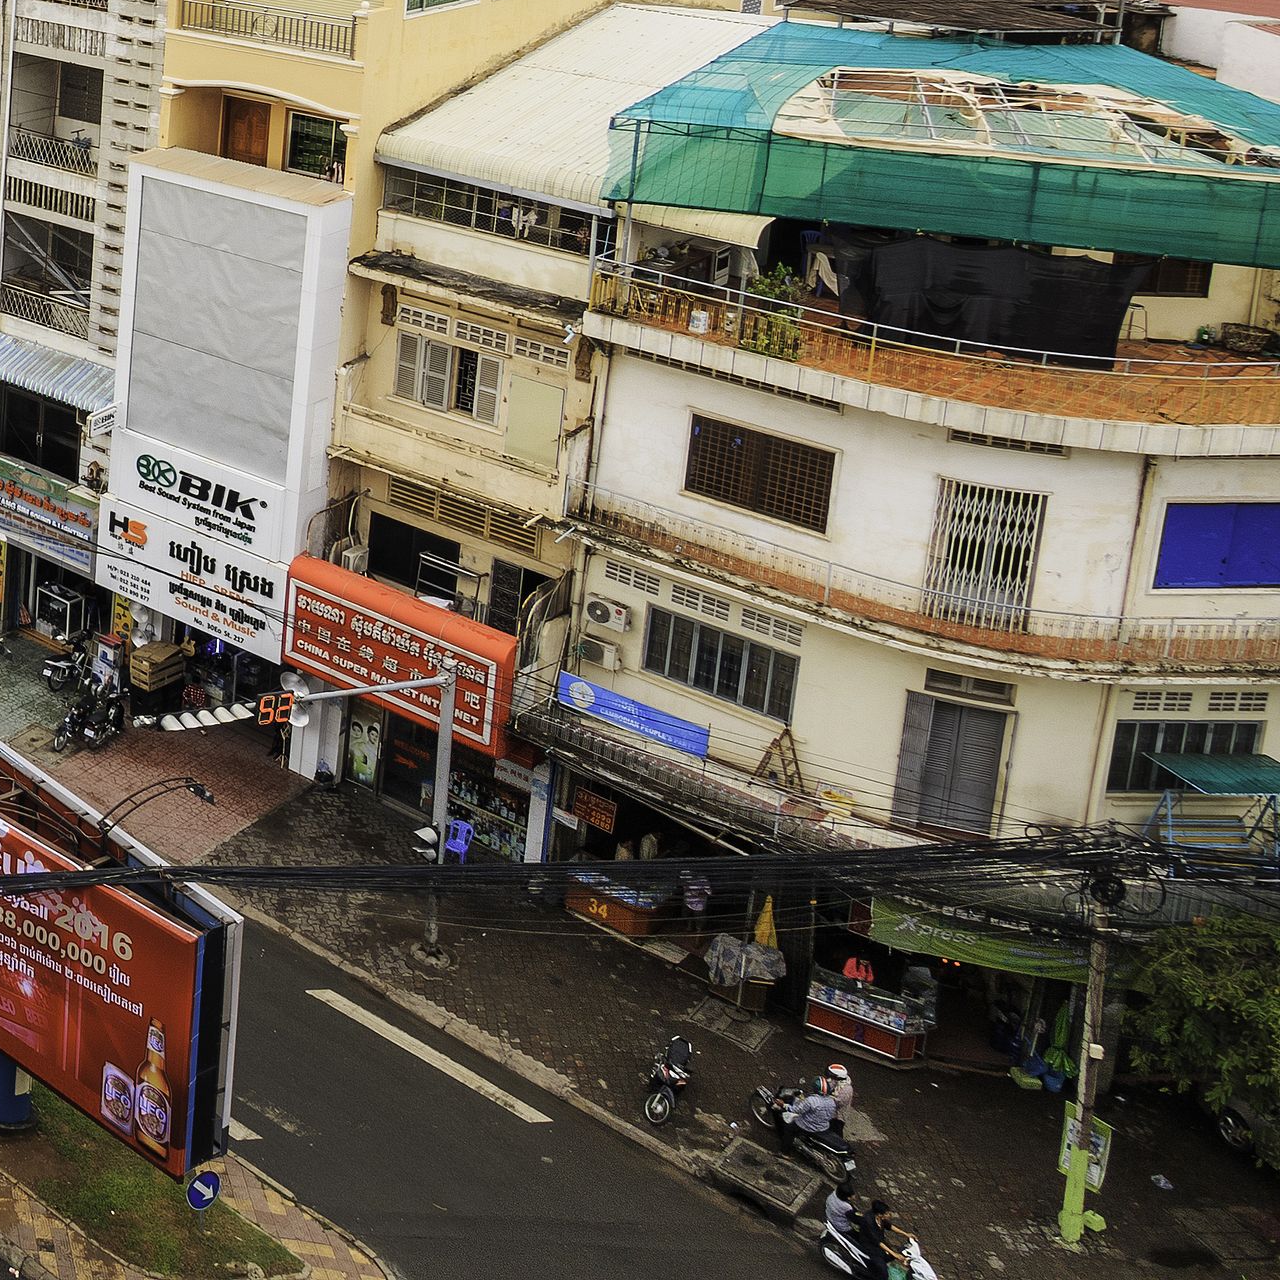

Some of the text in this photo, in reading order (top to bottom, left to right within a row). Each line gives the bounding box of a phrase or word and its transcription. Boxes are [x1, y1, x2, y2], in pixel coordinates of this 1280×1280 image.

[138, 479, 256, 534] Best Sound System from Japan
[178, 470, 259, 521] BIK
[30, 509, 51, 525] SOUND
[57, 522, 89, 541] LIGHTING
[174, 596, 257, 639] Sound & Music
[233, 634, 245, 644] 217
[296, 639, 330, 662] CHINA
[332, 654, 368, 678] SUPER
[599, 706, 641, 730] CAMBODIAN
[640, 723, 673, 744] PEOPLE'S
[588, 898, 608, 919] 34
[54, 903, 133, 961] 2016
[105, 1082, 132, 1110] LEO
[139, 1094, 168, 1121] LEO
